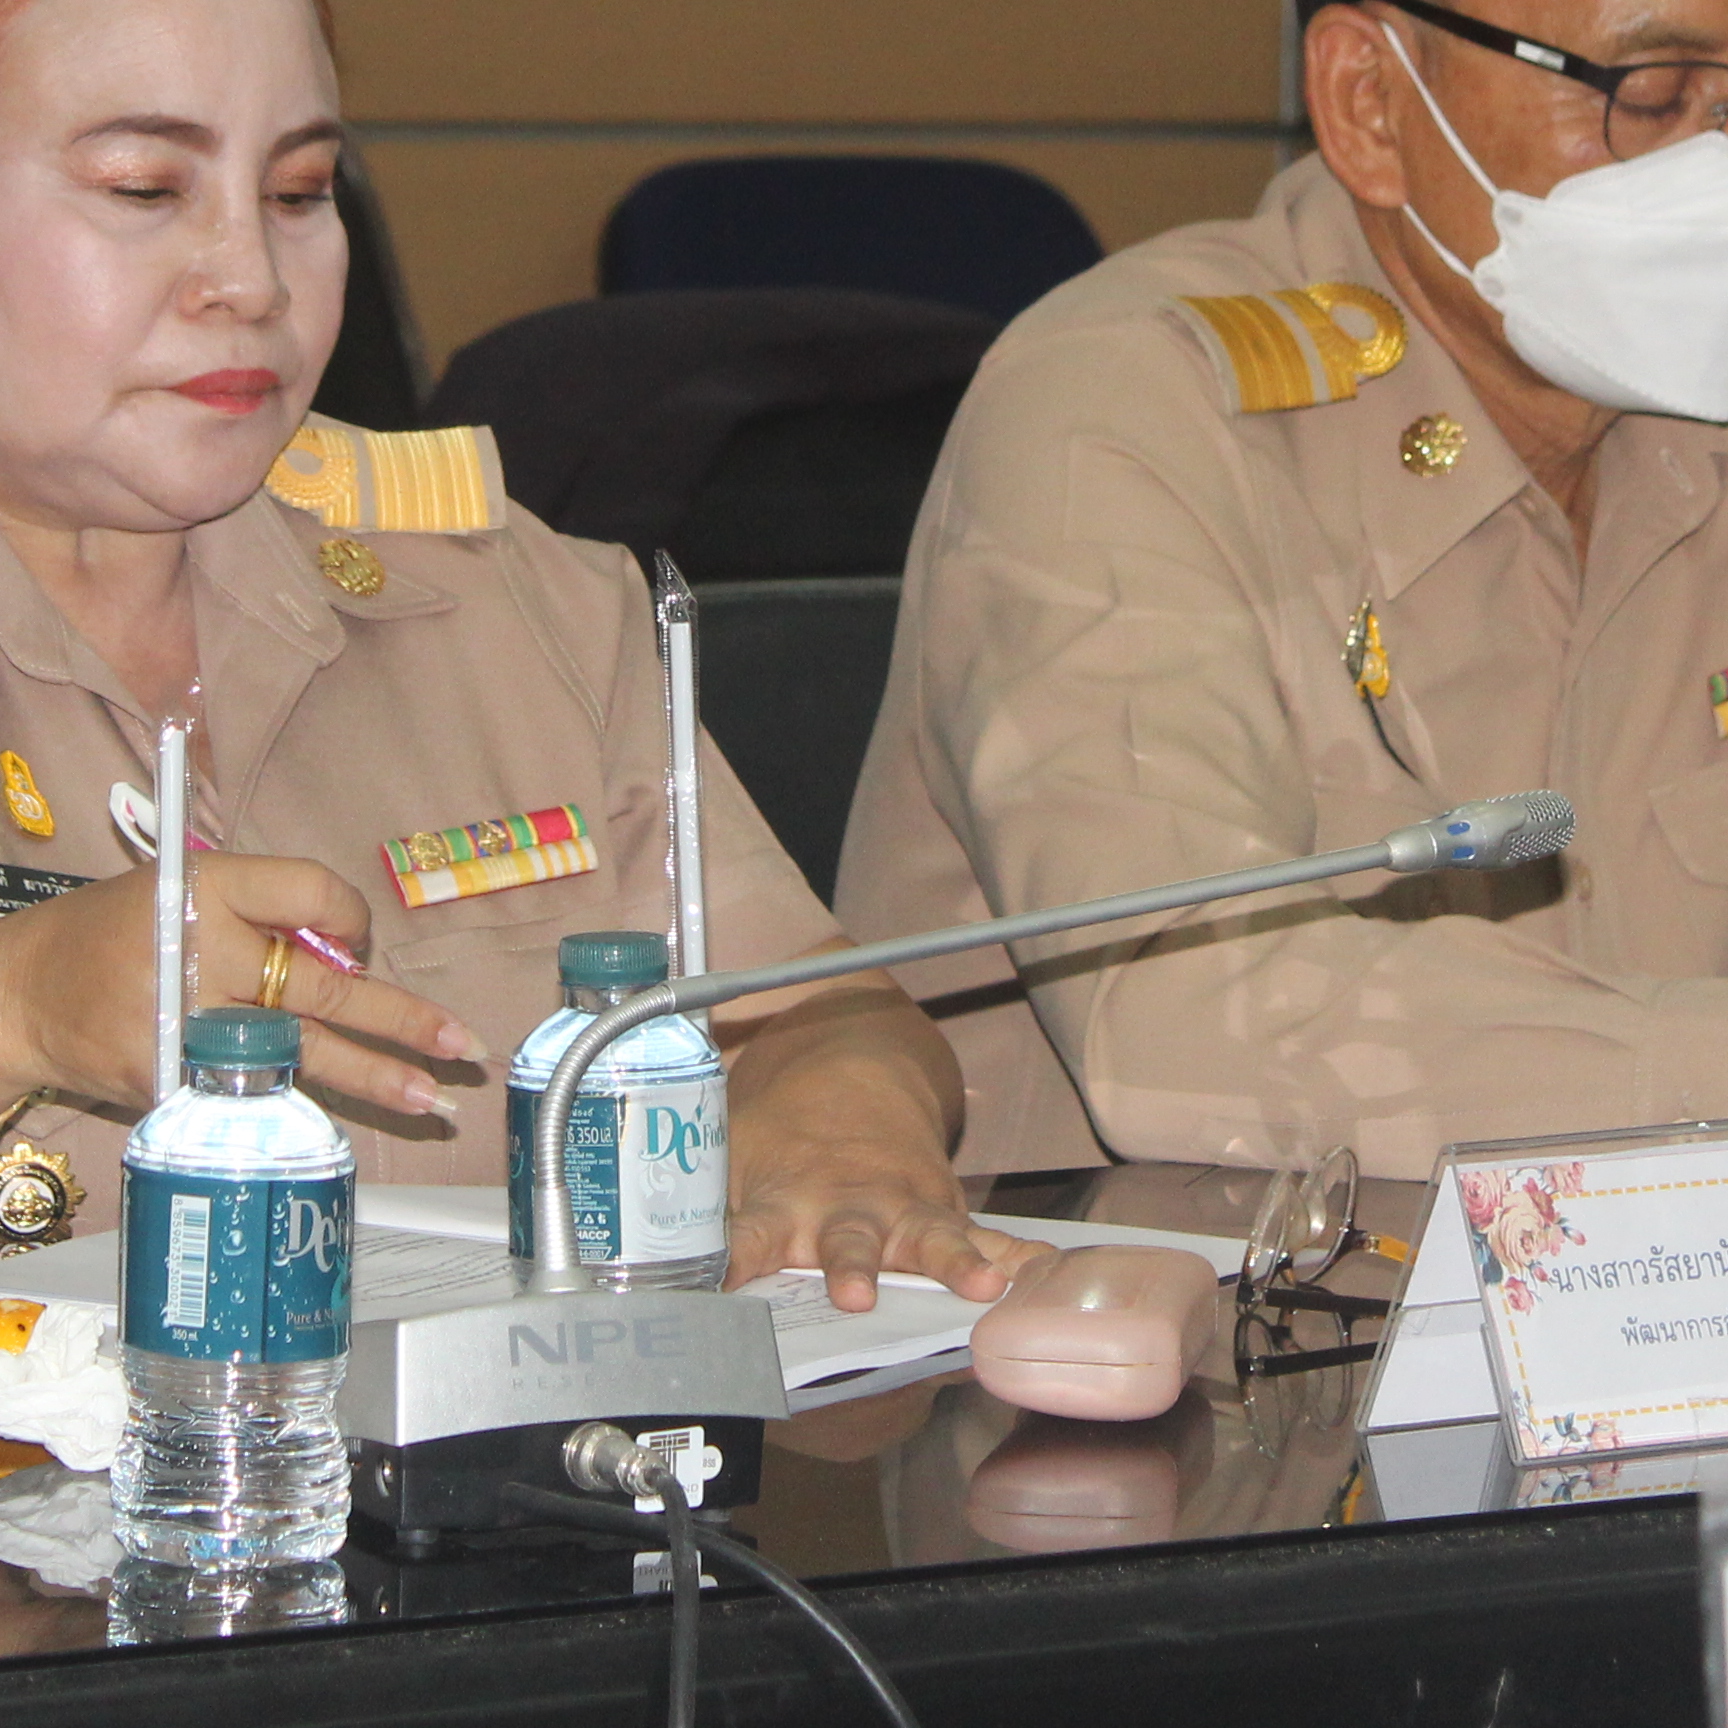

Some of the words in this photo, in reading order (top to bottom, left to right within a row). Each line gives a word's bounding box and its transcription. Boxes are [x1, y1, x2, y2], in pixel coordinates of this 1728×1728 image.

[576, 1126, 599, 1144] 350
[648, 1212, 677, 1225] Pure
[285, 1309, 312, 1326] Pure
[507, 1315, 688, 1369] NPE
